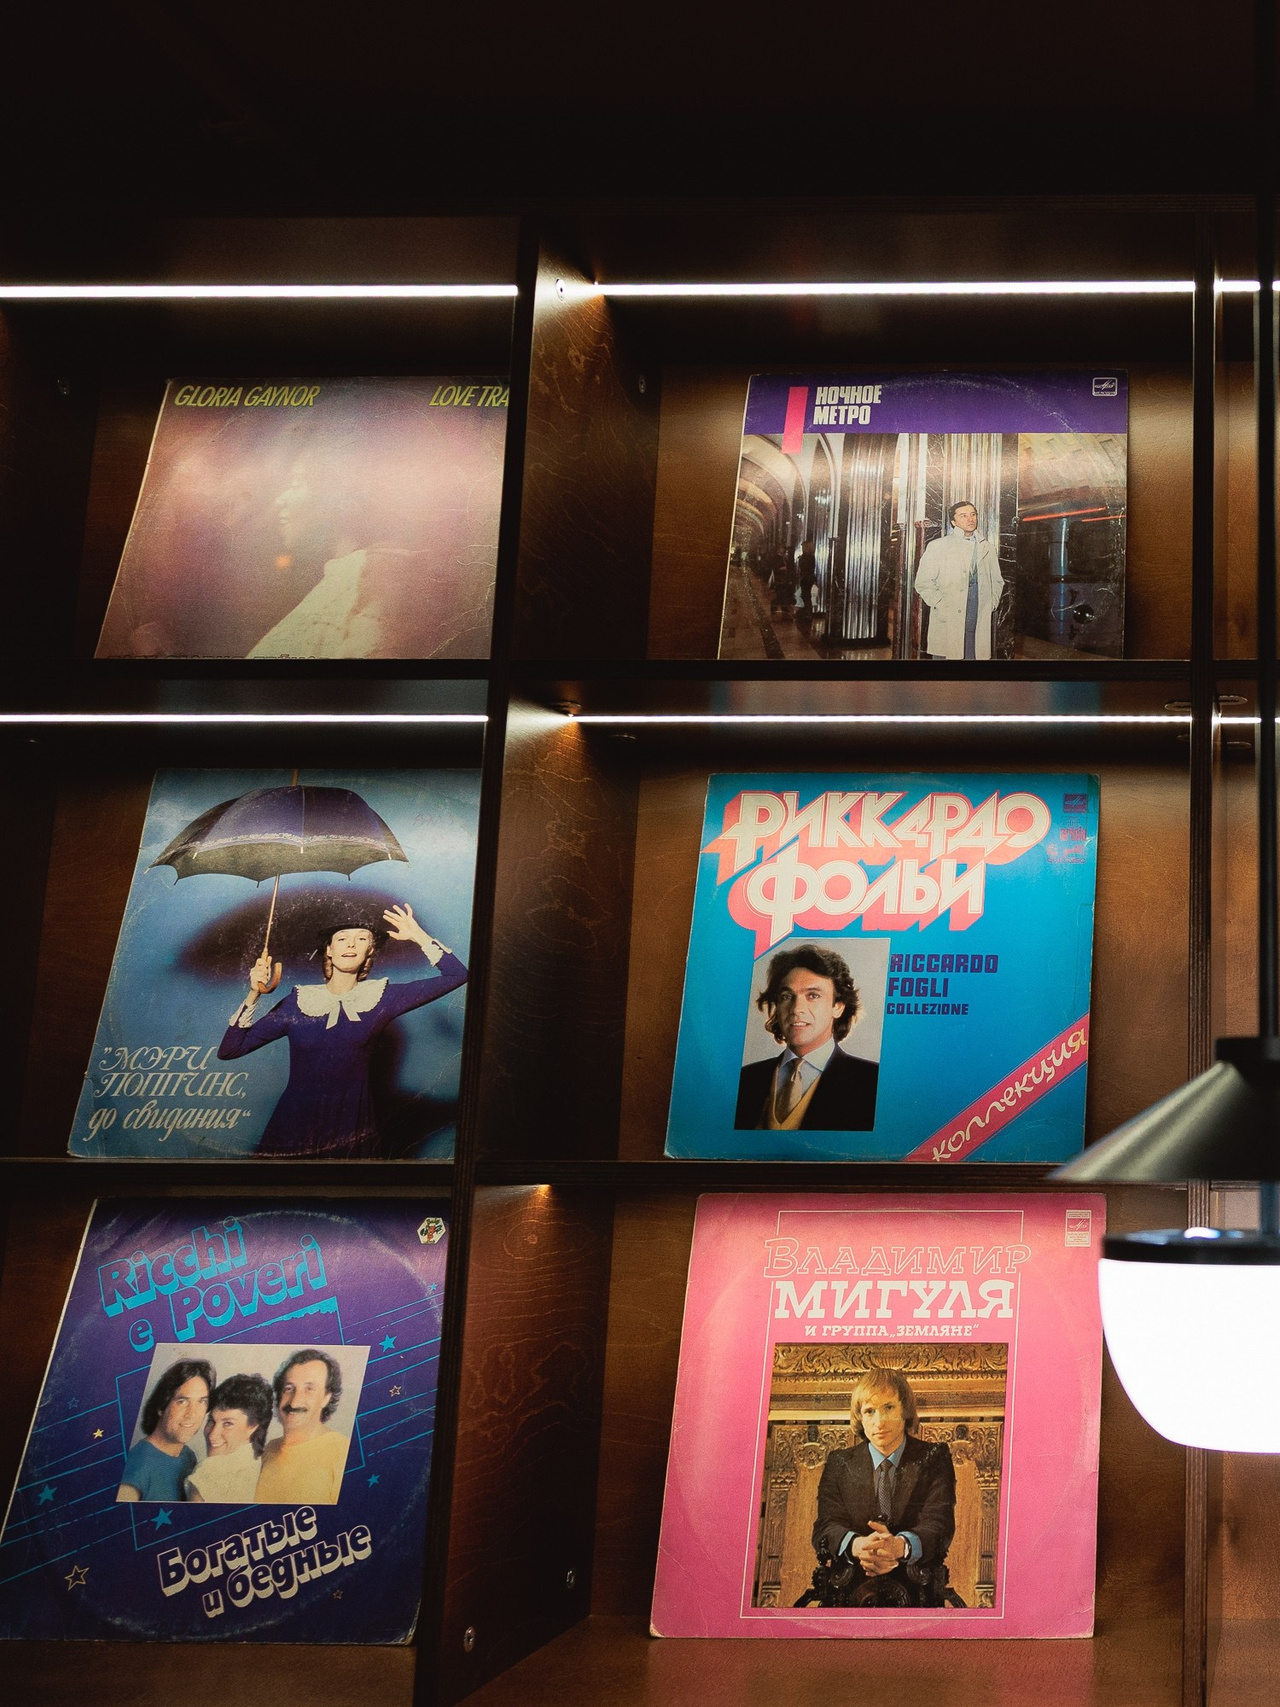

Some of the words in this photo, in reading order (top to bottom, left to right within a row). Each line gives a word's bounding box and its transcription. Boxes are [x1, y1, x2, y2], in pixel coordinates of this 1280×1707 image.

[174, 385, 241, 407] GLORIA
[243, 385, 321, 407] GAYNOR
[429, 385, 481, 407] LOVE
[815, 385, 882, 405] НОЧНОЕ
[813, 405, 871, 425] МЕТРО
[712, 790, 1051, 878] РИККАРДО
[732, 846, 987, 955] ФОЛЬИ
[890, 954, 998, 973] RICCARDO
[888, 977, 949, 998] FOGLI
[886, 1003, 969, 1016] COLLEZIONE
[82, 1108, 117, 1142] до
[97, 1215, 249, 1317] Ricchi
[128, 1318, 155, 1353] e
[169, 1234, 328, 1342] Poveri
[775, 1280, 1014, 1319] МИГУЛЯ
[804, 1325, 817, 1337] И
[822, 1325, 888, 1337] ГРУППА
[156, 1505, 318, 1597] Богатые
[202, 1590, 226, 1618] и
[226, 1524, 373, 1609] бедные
